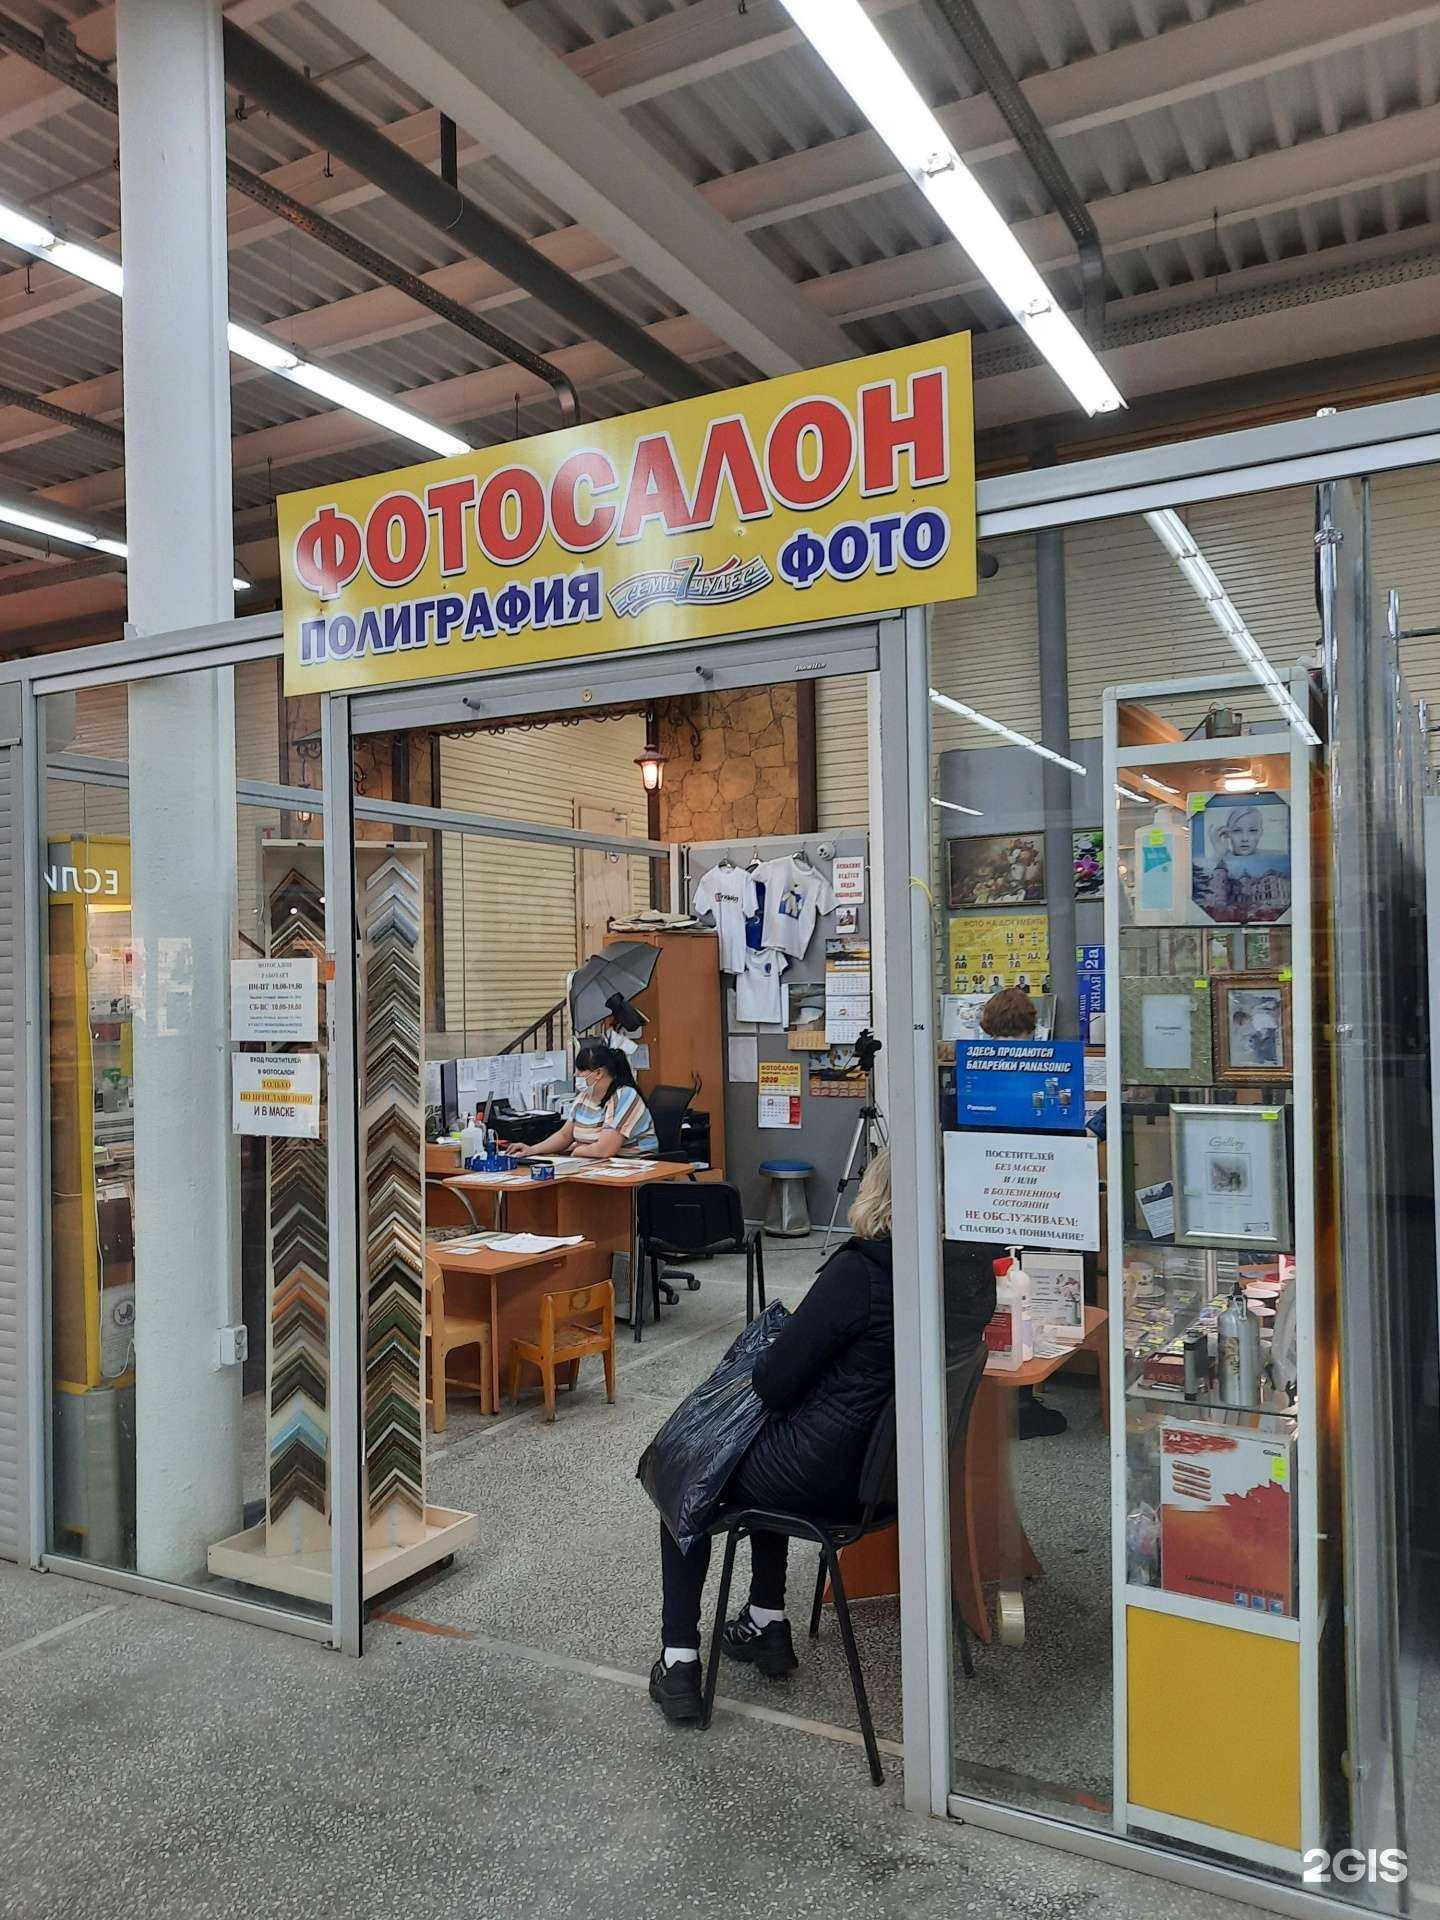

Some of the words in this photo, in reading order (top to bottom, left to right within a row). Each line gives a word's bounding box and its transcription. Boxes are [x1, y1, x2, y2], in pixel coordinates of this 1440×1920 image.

[294, 368, 949, 602] ФОТОСАЛОН
[780, 509, 948, 586] ФОТО
[673, 556, 703, 600] 7
[299, 567, 603, 664] ПОЛИГРАФИЯ
[966, 1046, 996, 1057] ЗДЕСЬ
[997, 1046, 1054, 1058] ПРОДАЮТСЯ
[966, 1059, 1018, 1071] БАТАРЕЙКИ
[1019, 1061, 1072, 1073] PANASONIC
[254, 1106, 260, 1115] И
[261, 1106, 267, 1116] В
[269, 1106, 295, 1117] МАСКЕ
[985, 1150, 1055, 1161] ПОСЕТИТЕЛЕЙ
[994, 1163, 1011, 1171] БЕЗ
[1012, 1163, 1046, 1173] МАСКИ
[1017, 1177, 1038, 1185] ИЛИ
[991, 1188, 1061, 1199] БОЛЕЗНЕННОМ
[992, 1199, 1050, 1210] СОСТОЯНИИ
[965, 1210, 982, 1219] НЕ
[959, 1224, 1005, 1235] СПАСИБО
[1006, 1227, 1018, 1235] ЗА
